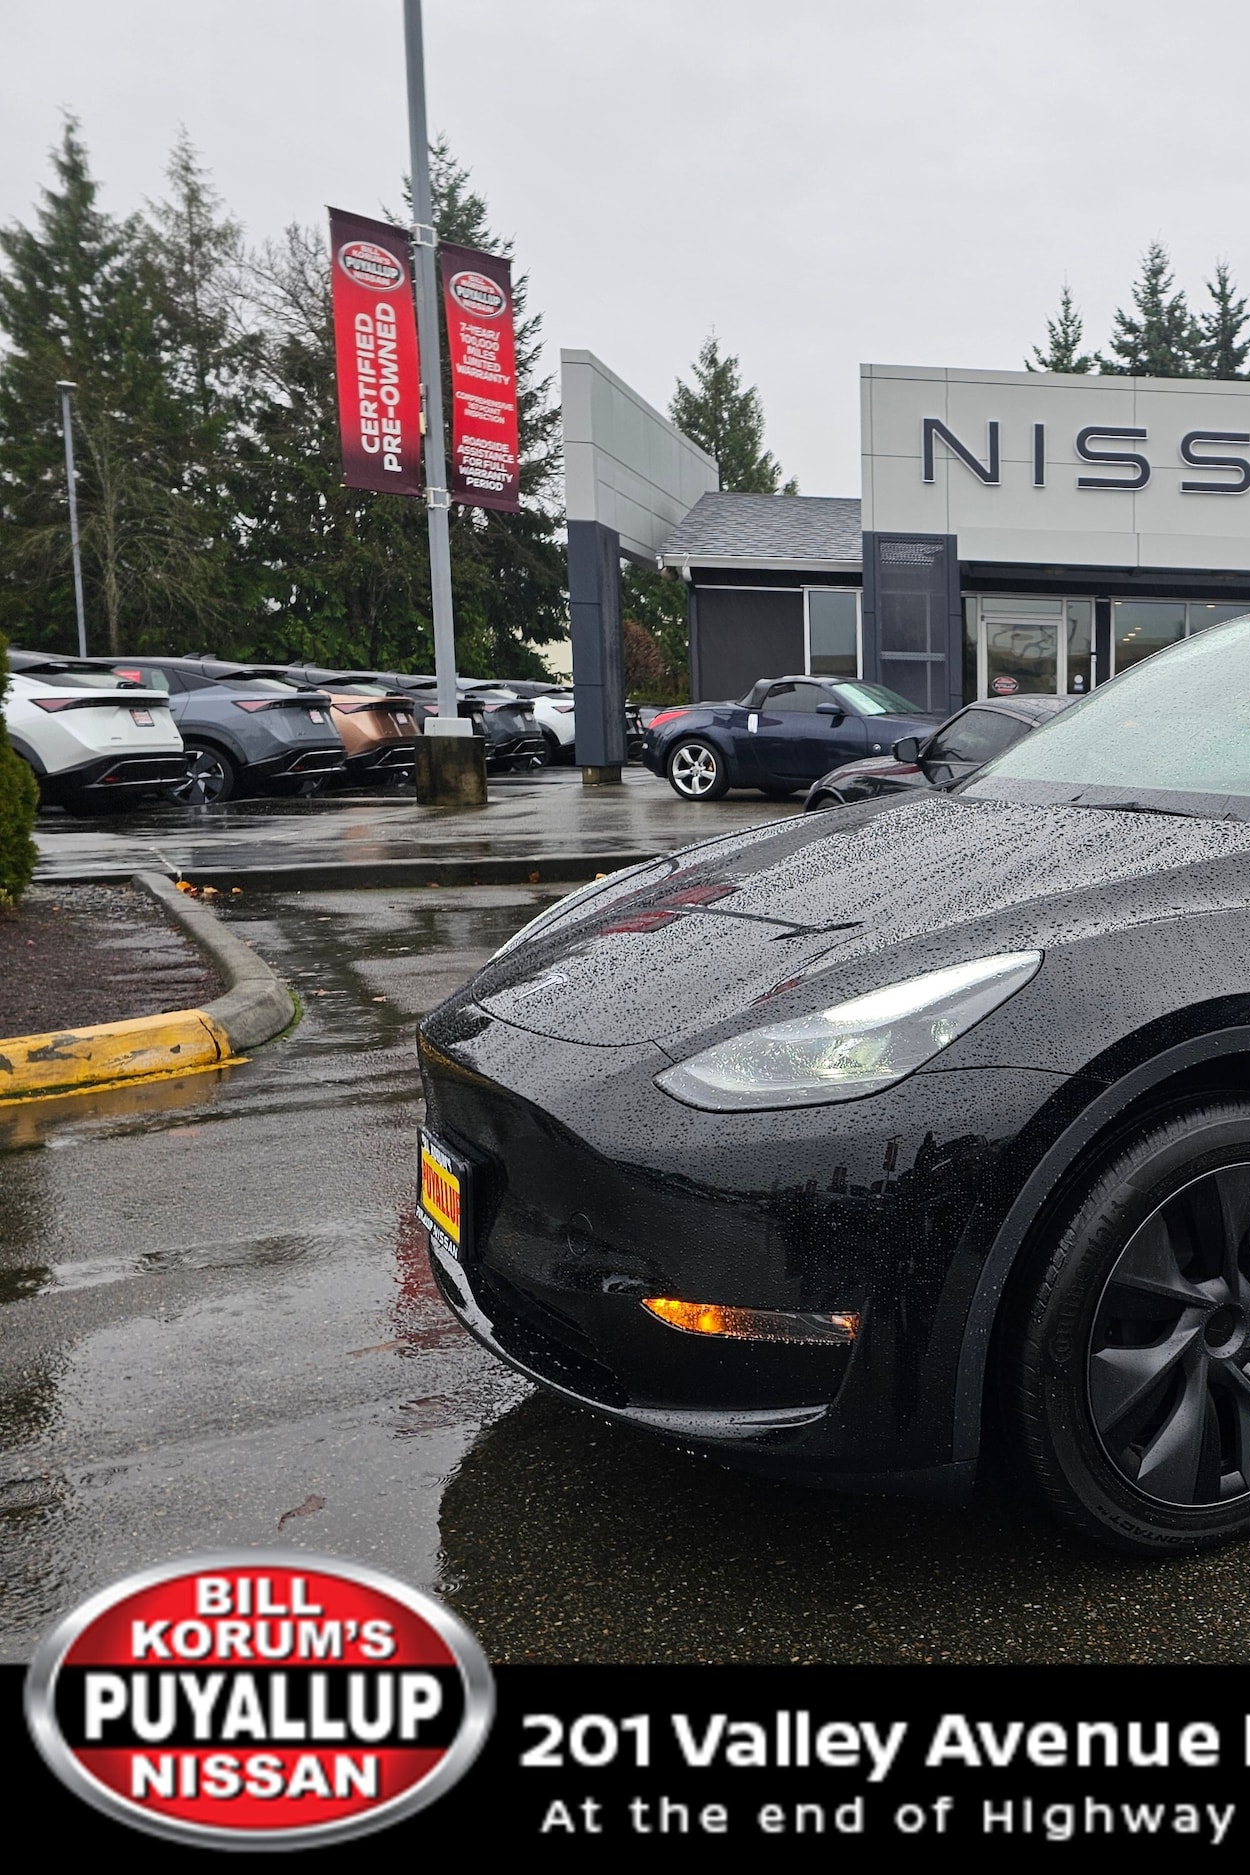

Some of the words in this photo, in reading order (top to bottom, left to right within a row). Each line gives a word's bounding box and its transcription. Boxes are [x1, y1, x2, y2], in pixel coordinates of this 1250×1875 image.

[355, 312, 380, 454] CERTIFIED
[456, 363, 510, 385] WARRANTY
[375, 302, 402, 472] PRE-OWNED
[457, 444, 514, 464] ASSISTANCE
[462, 435, 509, 453] ROADSIDE
[459, 465, 513, 483] WARRANTY
[463, 455, 483, 467] FOR
[483, 460, 507, 473] FULL
[466, 476, 503, 492] PERIOD
[433, 1224, 459, 1260] NISSAN
